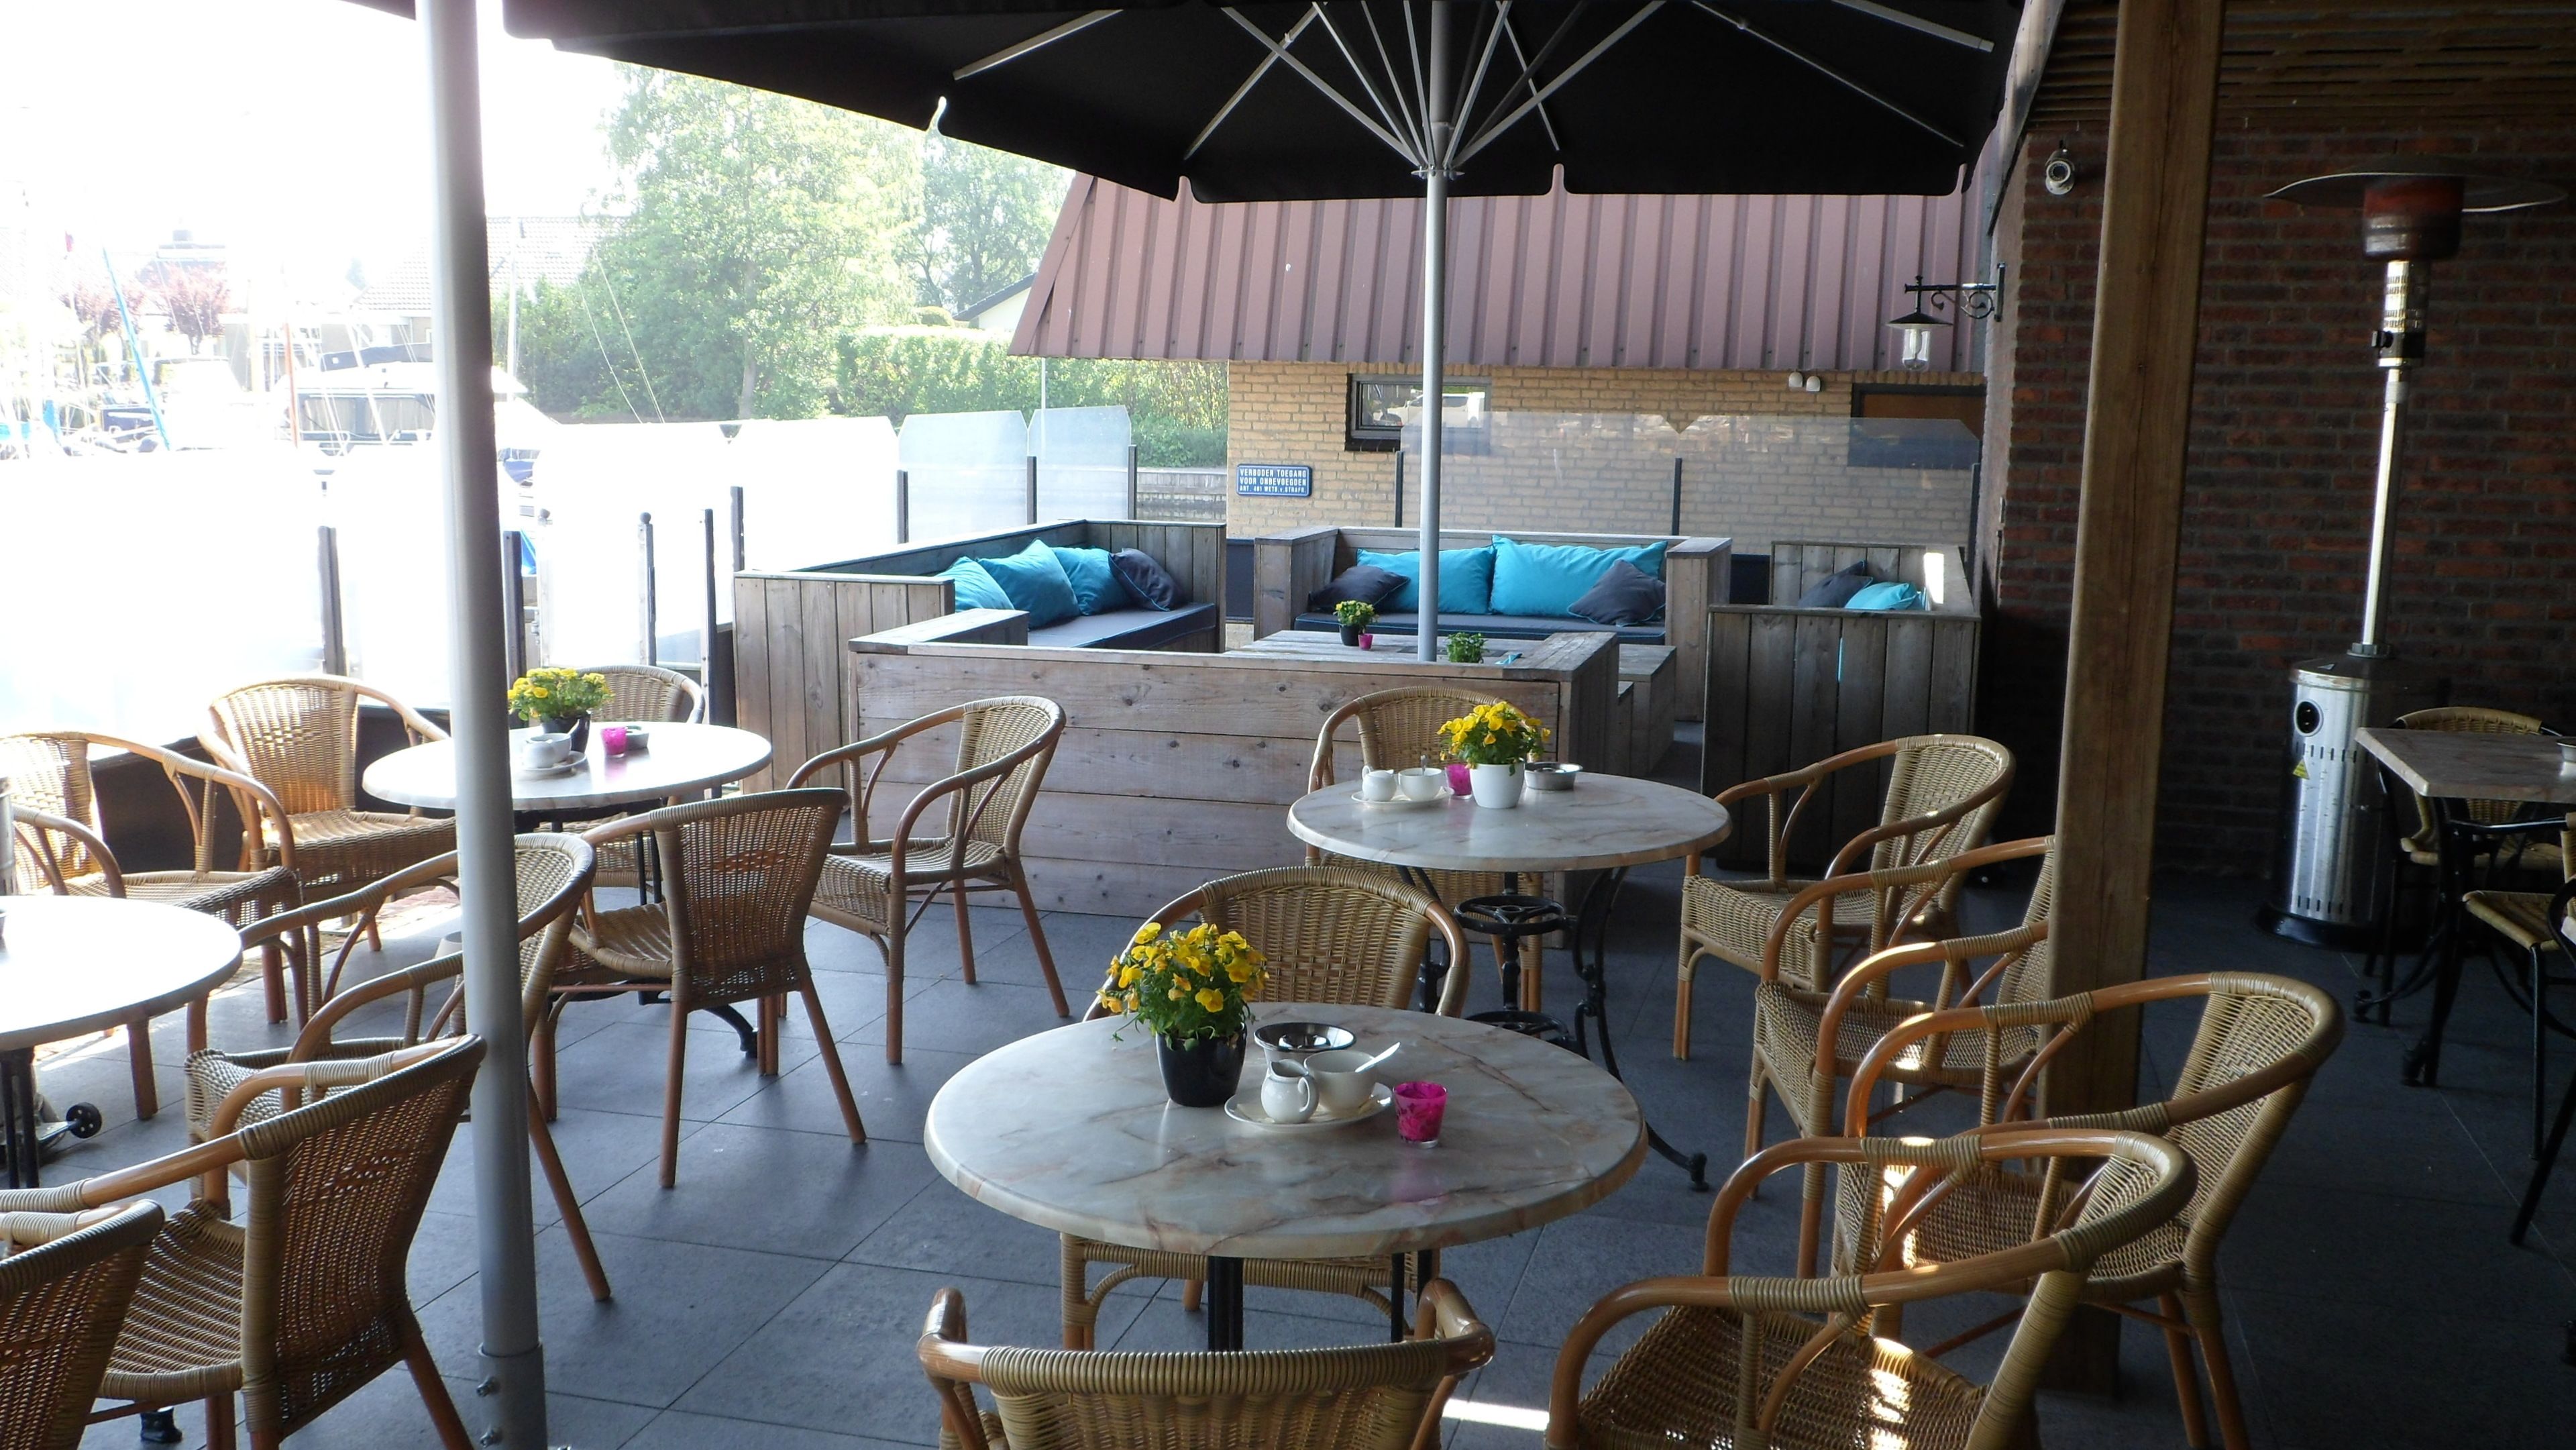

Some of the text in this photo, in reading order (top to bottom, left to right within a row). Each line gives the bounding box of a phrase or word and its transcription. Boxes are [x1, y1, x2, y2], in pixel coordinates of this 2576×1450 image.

[1240, 468, 1307, 478] VERBODEN TOEGANG
[1240, 476, 1307, 486] VOOR ONBEVOEGDEN
